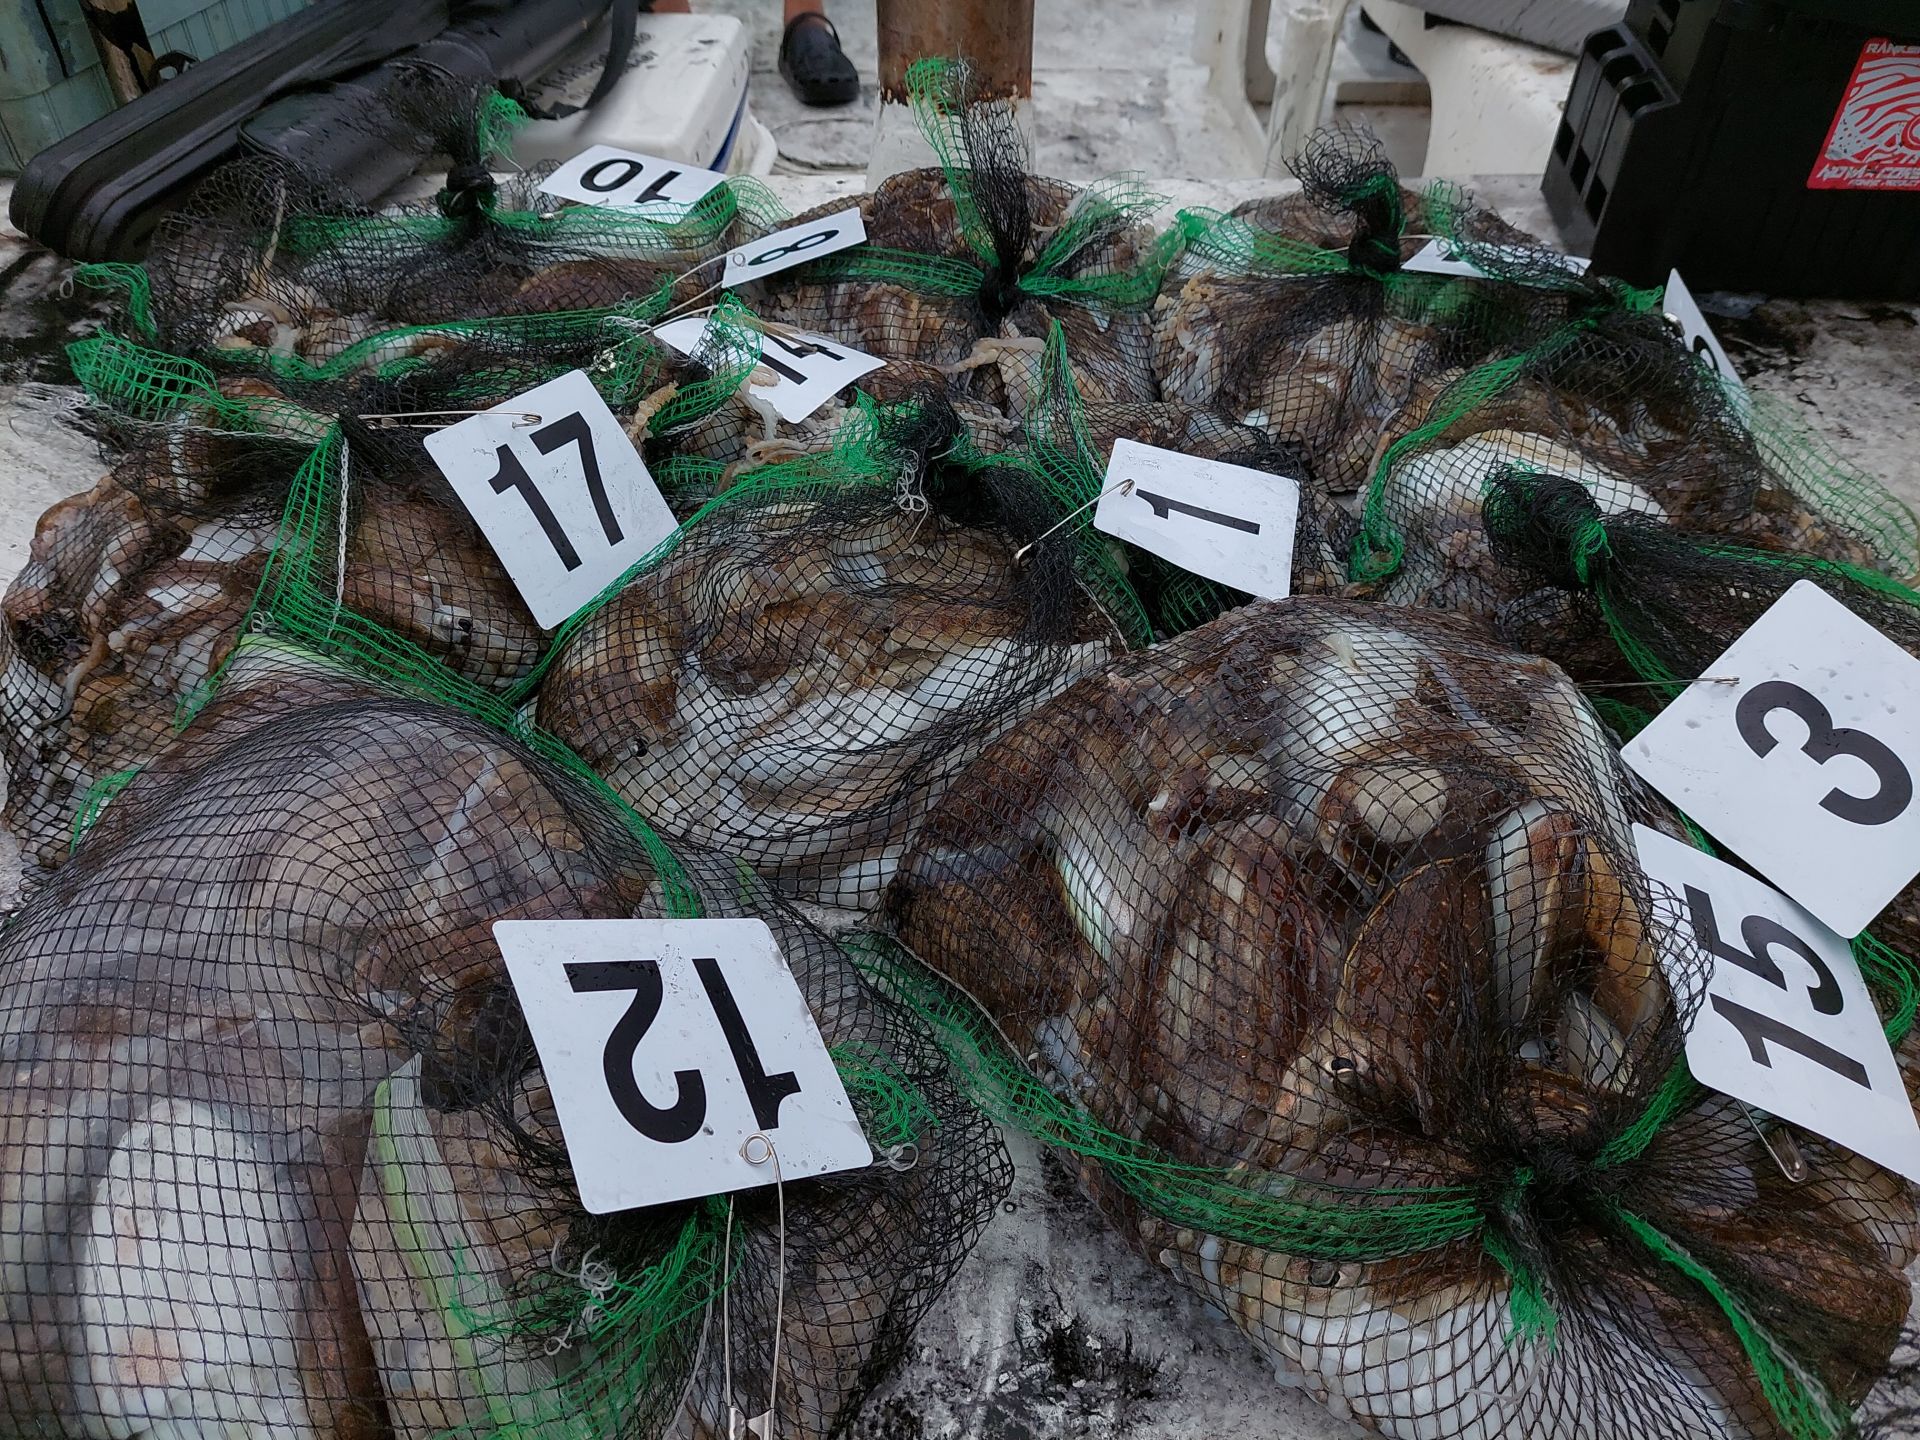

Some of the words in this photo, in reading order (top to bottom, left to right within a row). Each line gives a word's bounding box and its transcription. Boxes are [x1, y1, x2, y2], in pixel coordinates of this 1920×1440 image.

[580, 158, 682, 203] 10
[747, 229, 840, 266] 8
[487, 410, 625, 572] 17
[1136, 488, 1261, 536] 1
[1735, 680, 1913, 825] 3
[562, 957, 802, 1144] 12
[1682, 882, 1872, 1091] 15
